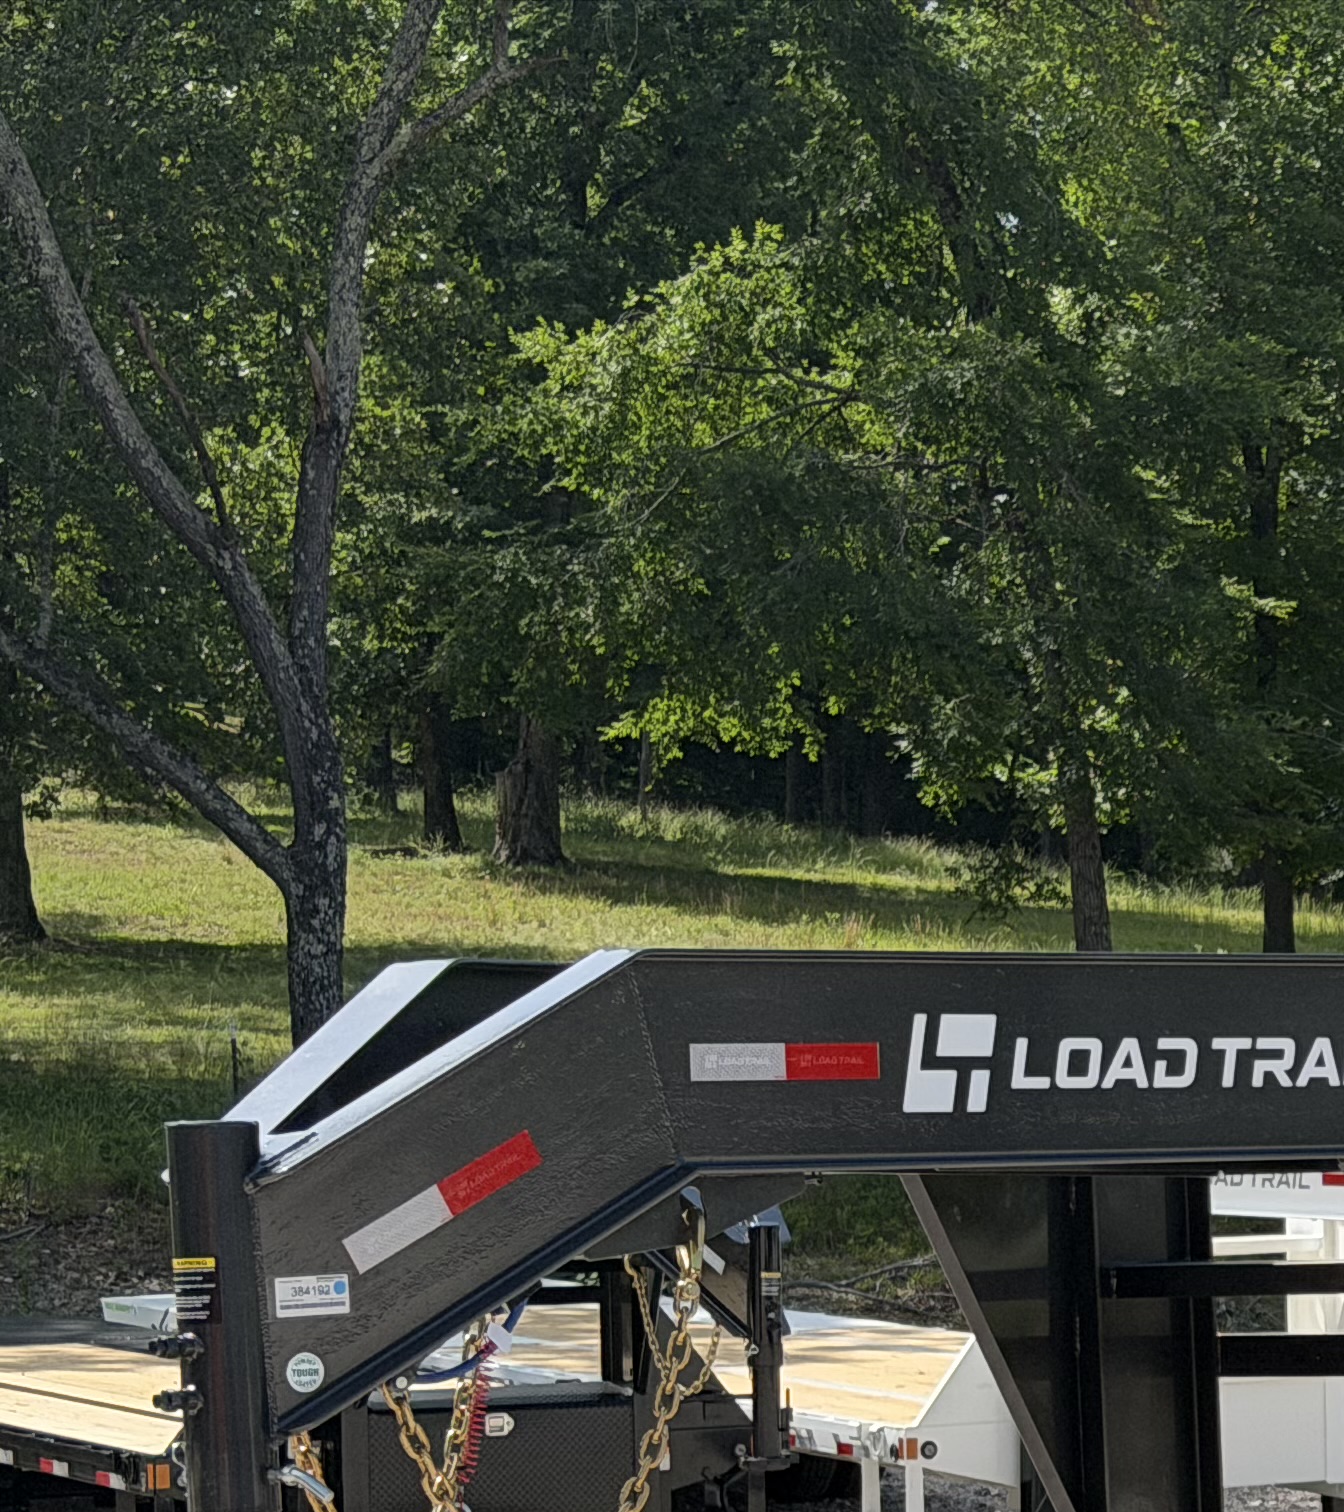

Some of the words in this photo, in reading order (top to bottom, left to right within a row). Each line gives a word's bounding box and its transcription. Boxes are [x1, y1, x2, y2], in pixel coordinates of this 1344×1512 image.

[1011, 1037, 1198, 1089] LOAD
[1212, 1174, 1243, 1187] AD
[1250, 1173, 1311, 1189] TRAIL
[291, 1368, 319, 1378] TOUGH
